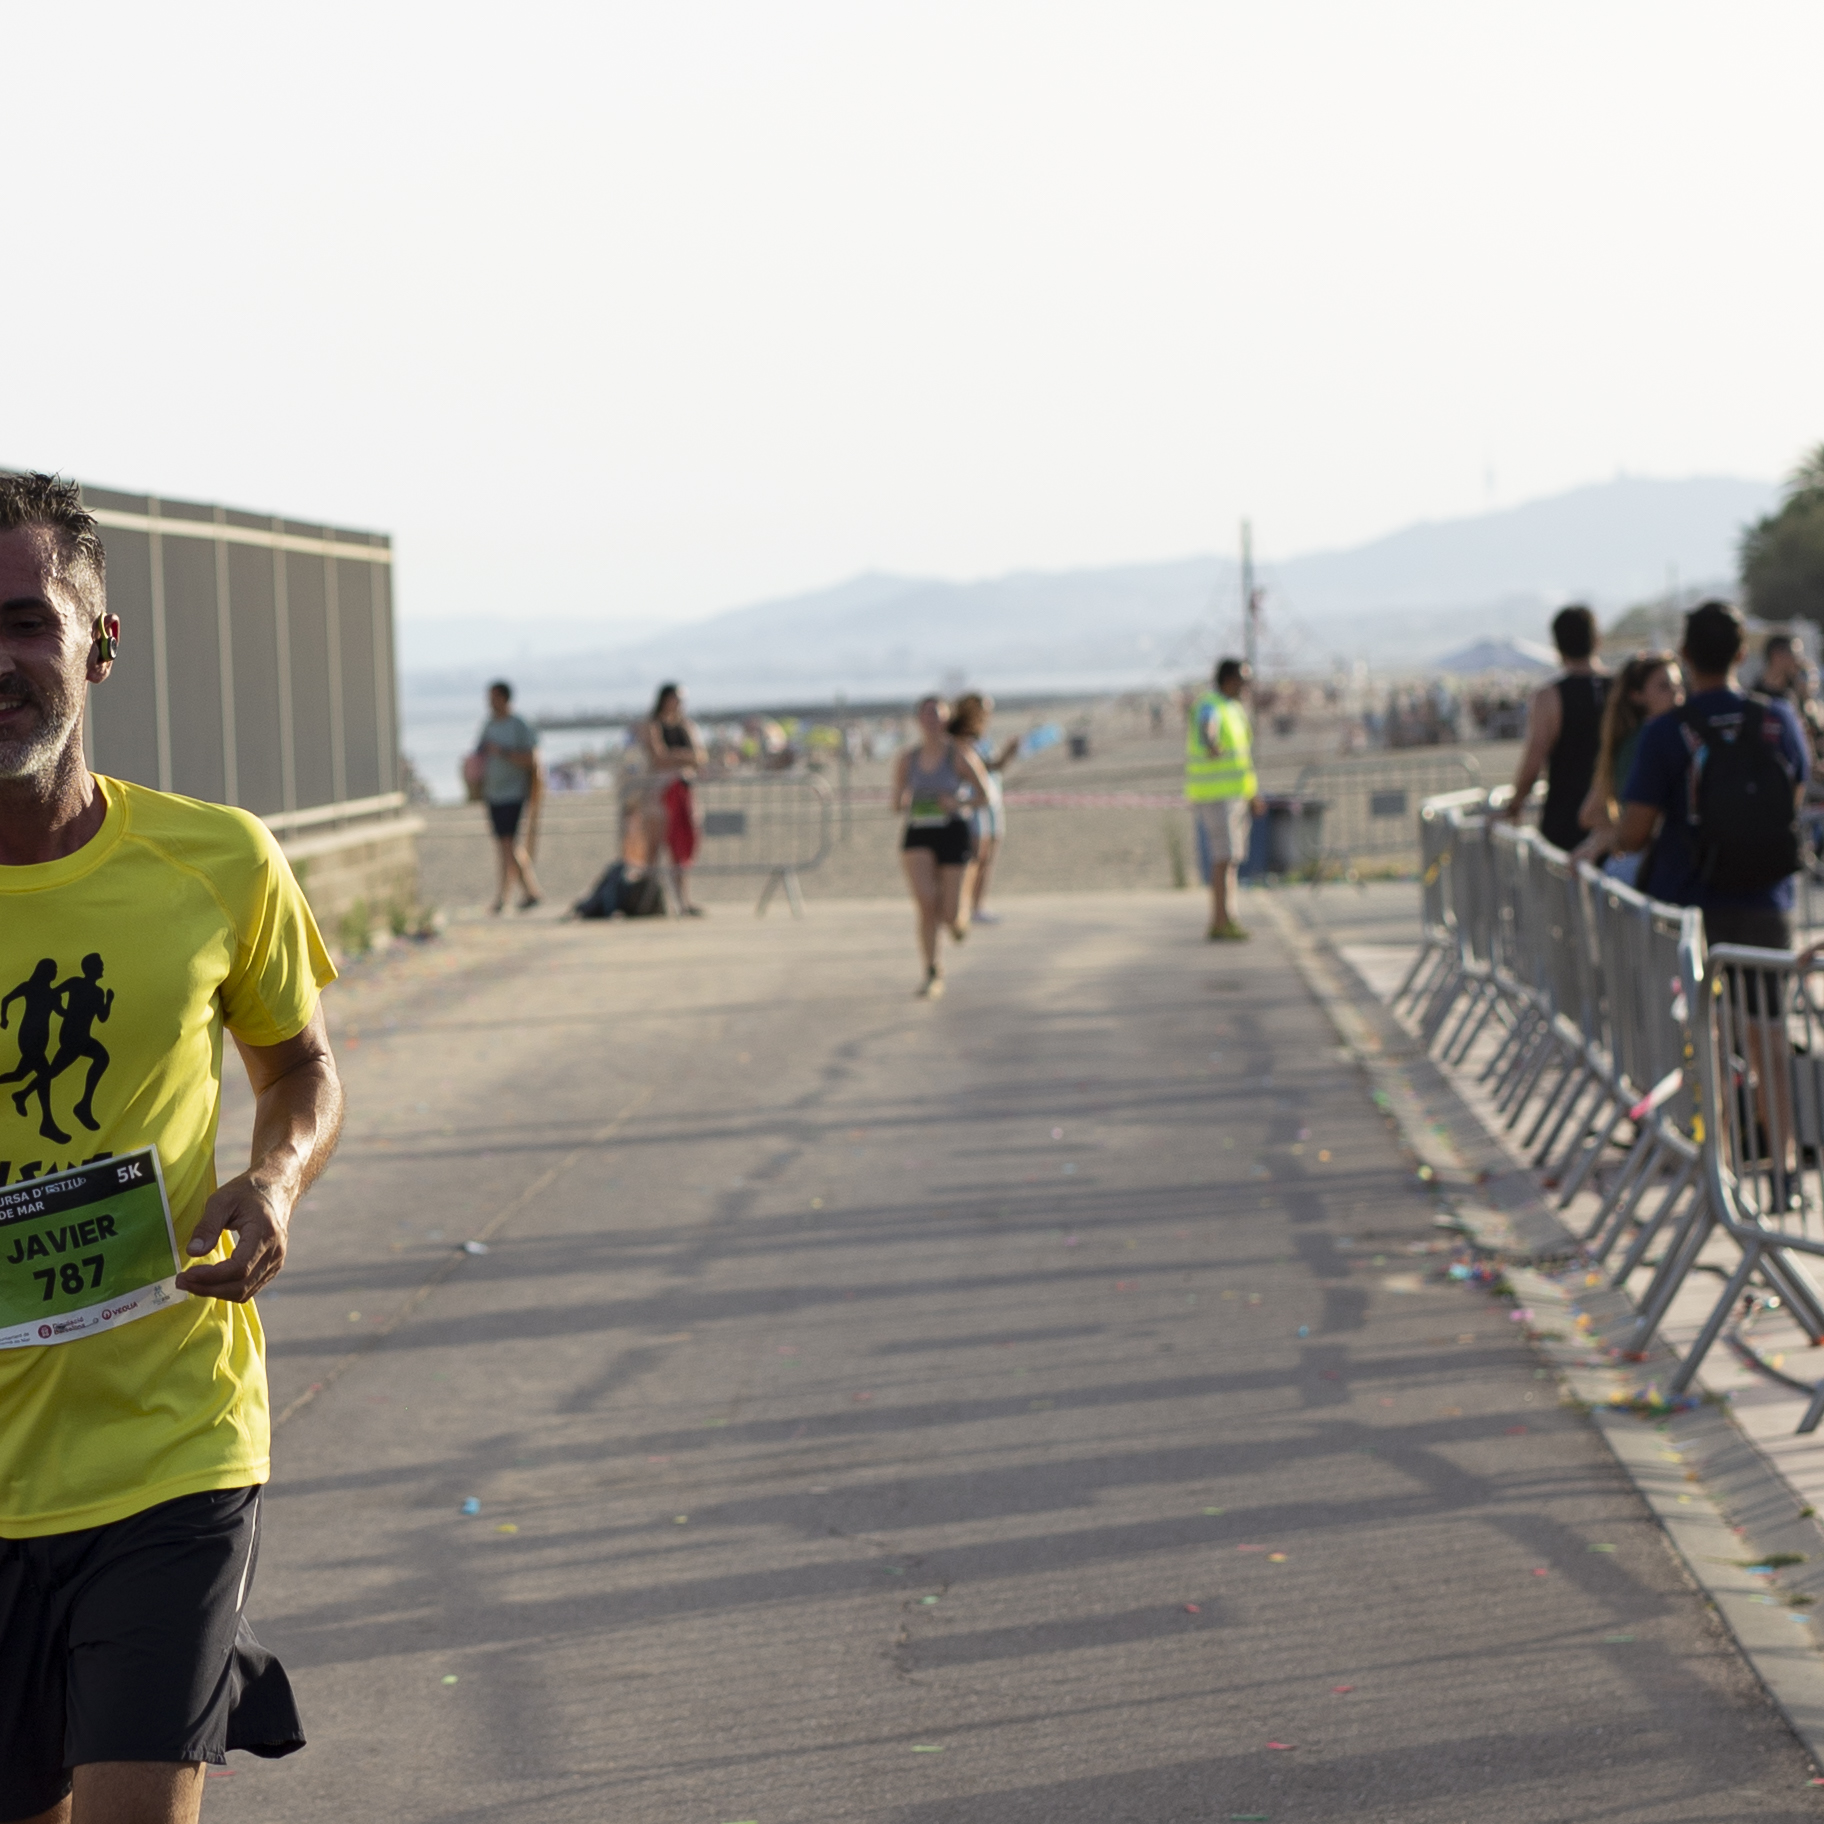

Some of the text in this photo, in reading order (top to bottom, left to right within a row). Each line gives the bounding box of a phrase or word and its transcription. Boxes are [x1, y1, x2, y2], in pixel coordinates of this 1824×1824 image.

[116, 1162, 143, 1184] 5K
[17, 1201, 45, 1217] MAR
[6, 1214, 118, 1265] JAVIER
[33, 1254, 107, 1301] 787
